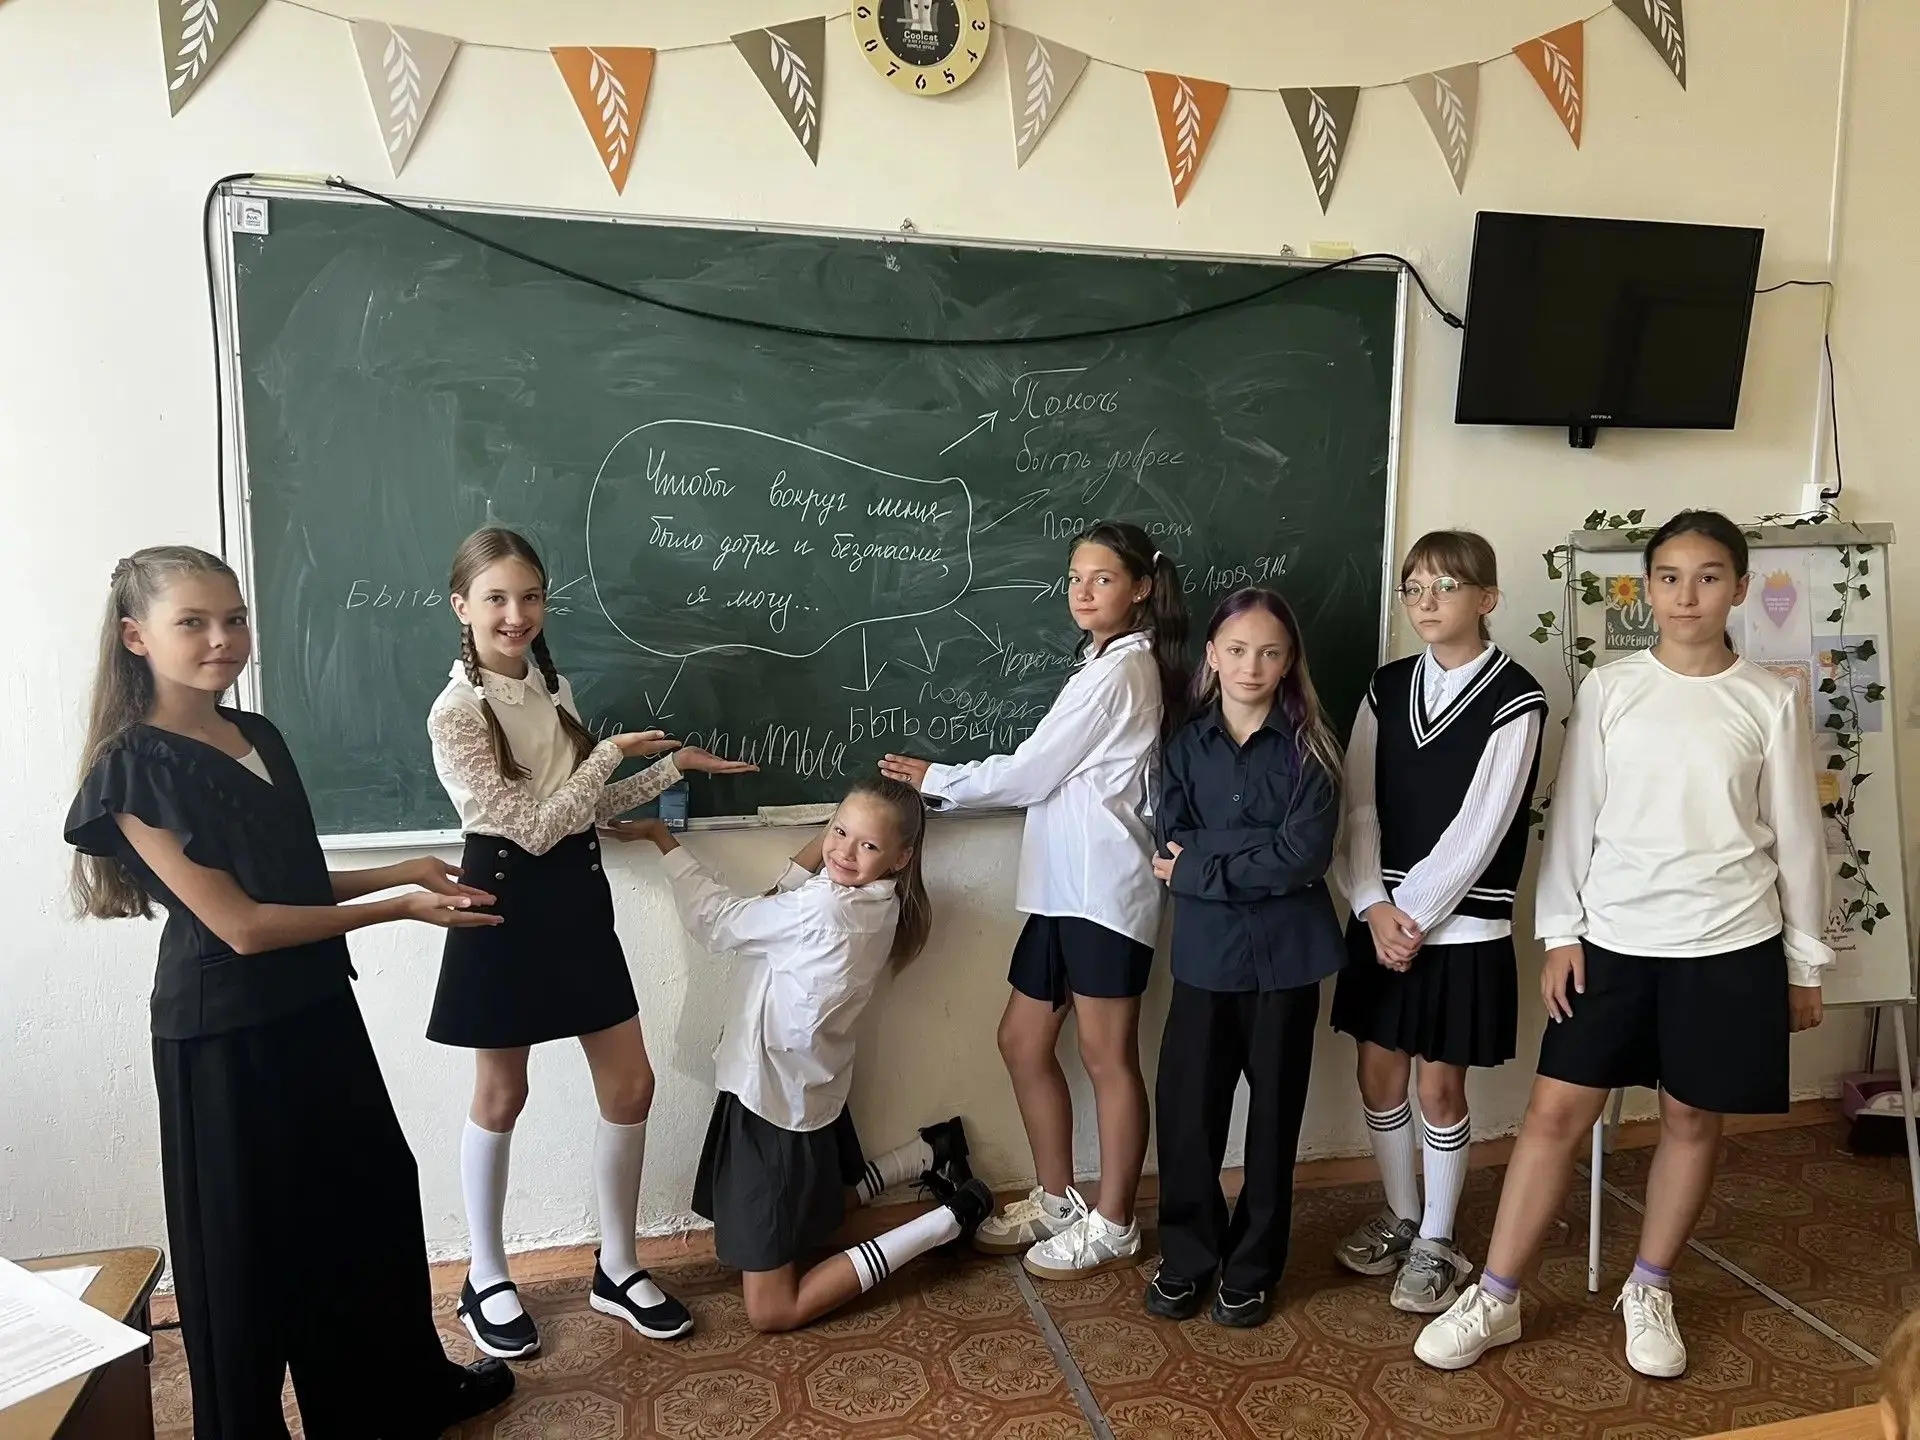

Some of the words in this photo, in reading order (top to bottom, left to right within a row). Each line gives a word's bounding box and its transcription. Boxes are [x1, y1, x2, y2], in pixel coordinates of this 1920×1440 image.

[903, 30, 939, 42] Coolcat
[1010, 367, 1120, 421] Помочь
[645, 448, 736, 497] Чтобы
[769, 470, 848, 525] вокруг
[867, 497, 952, 524] меня
[648, 515, 703, 551] было
[794, 538, 815, 554] и
[686, 586, 711, 607] я
[1607, 634, 1659, 647] ИСКРЕННОС
[849, 705, 921, 744] БЫТЬ
[928, 714, 1035, 750] ОБЩИТ
